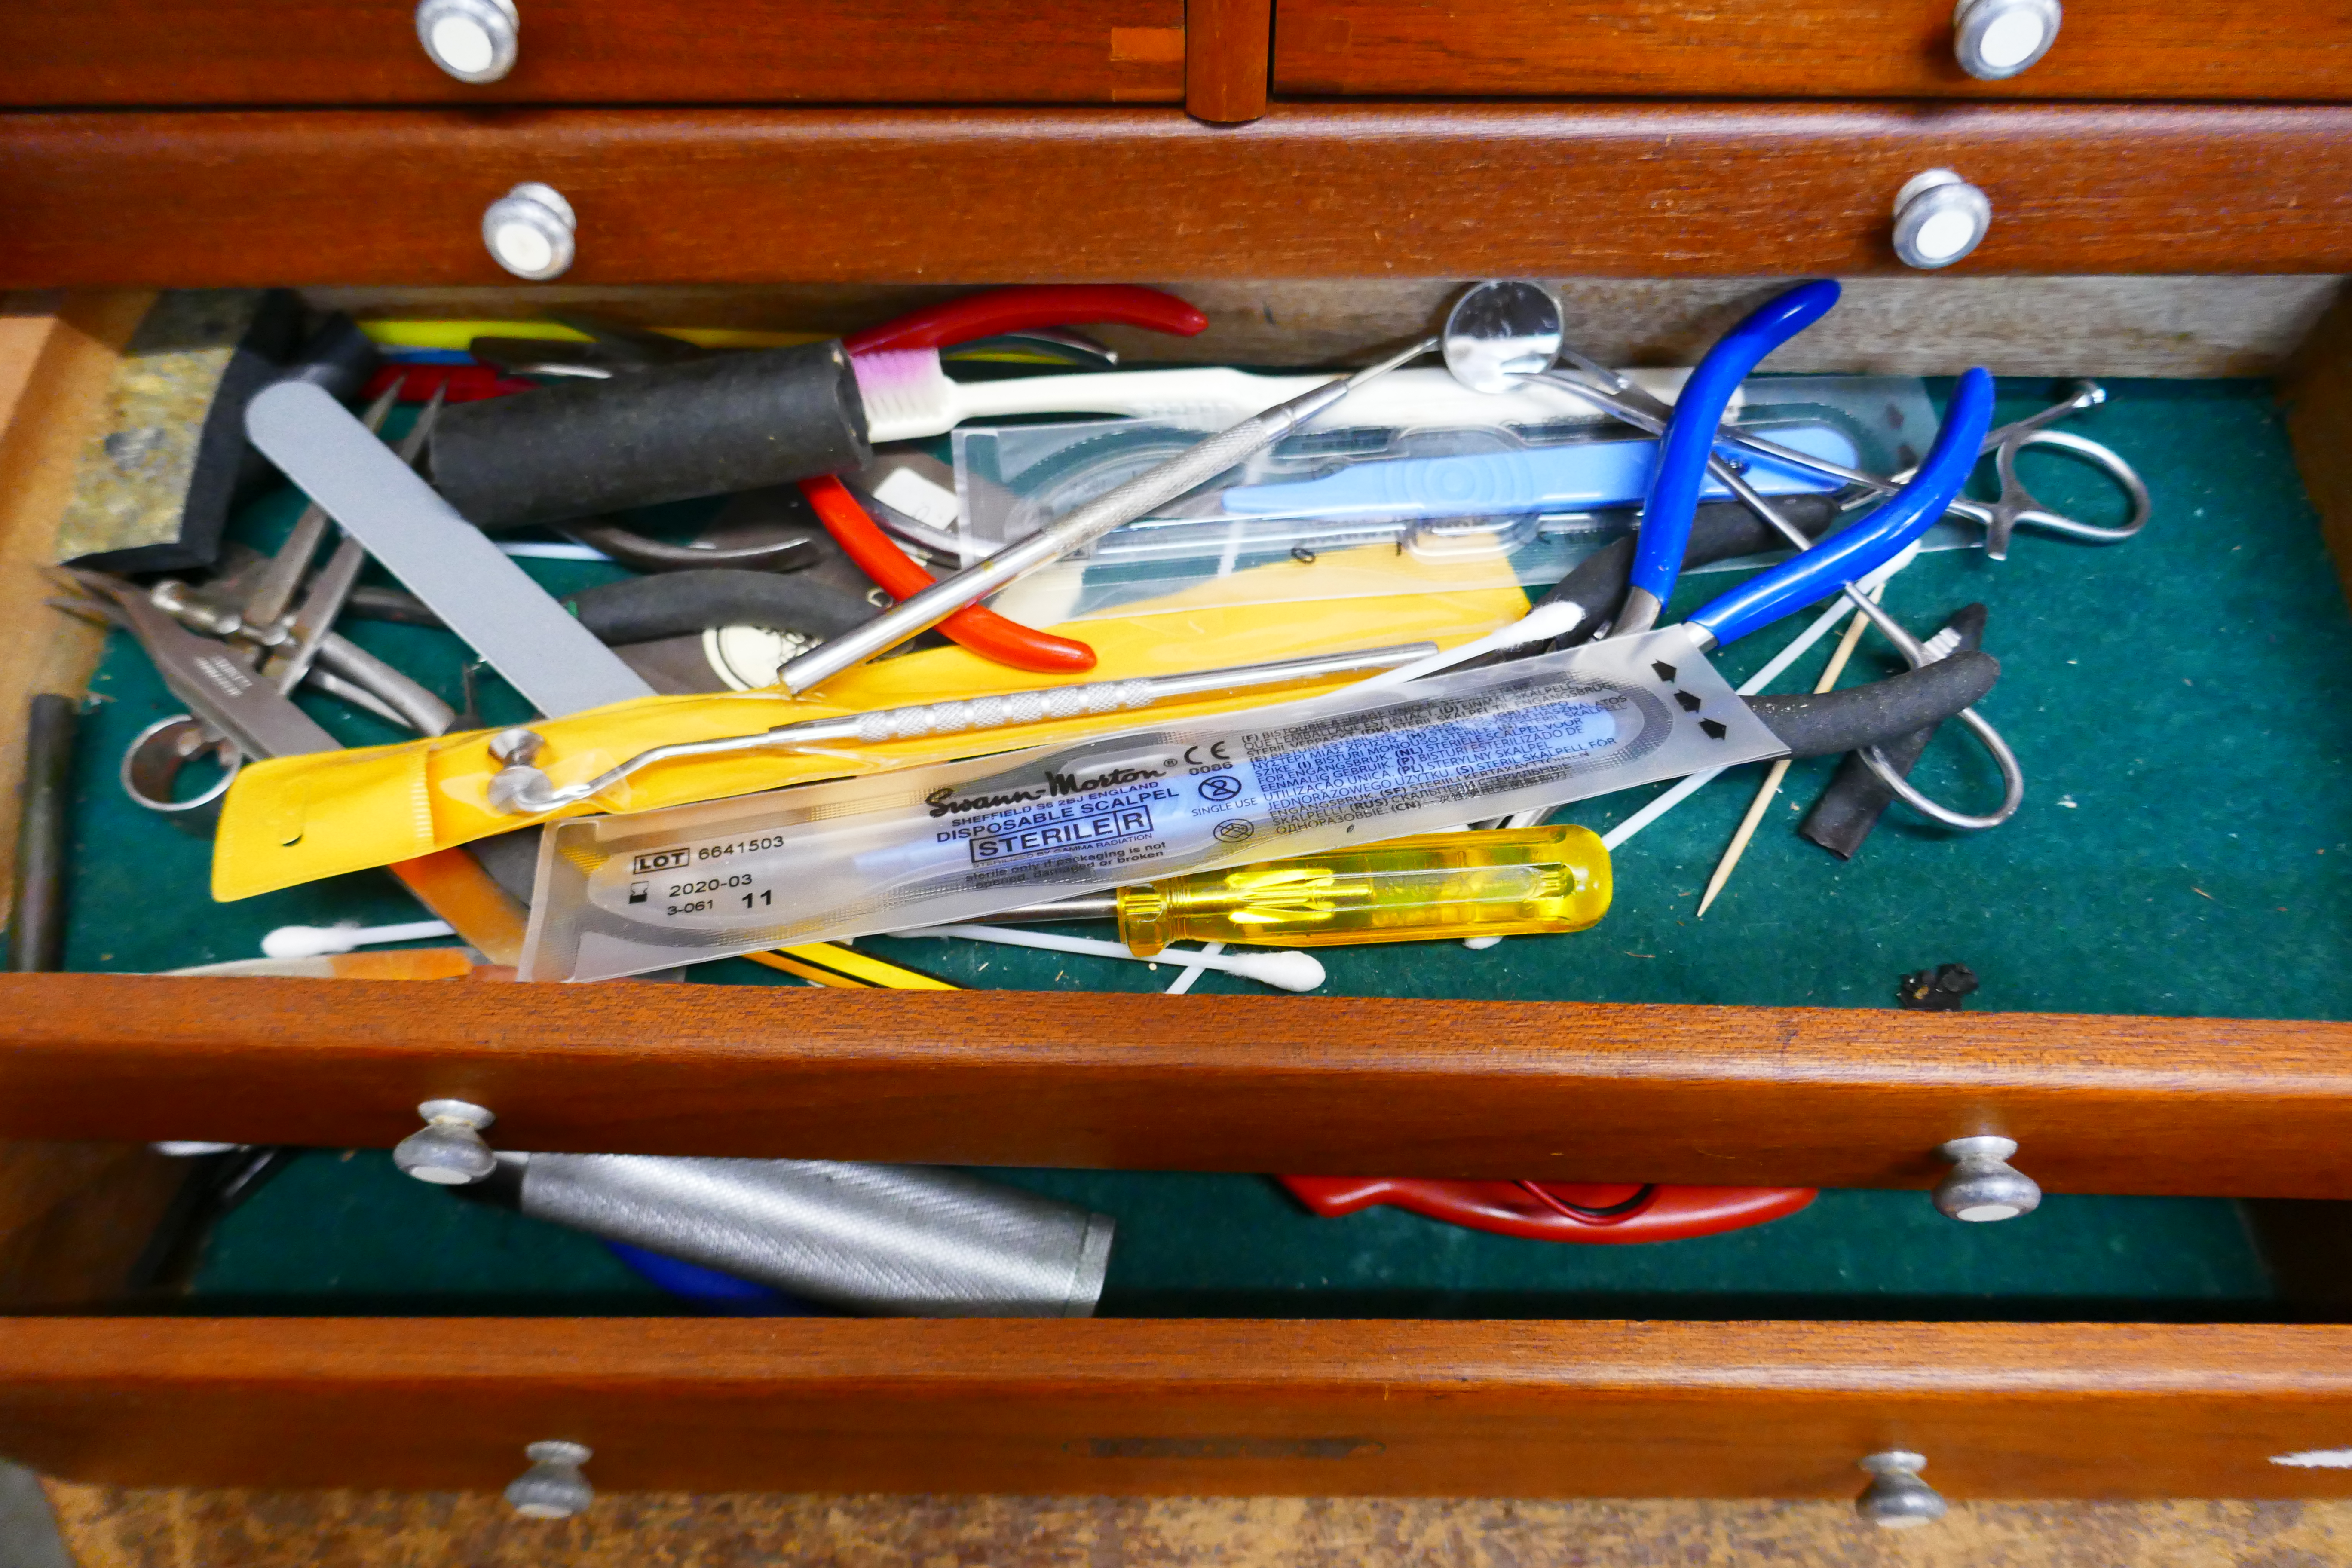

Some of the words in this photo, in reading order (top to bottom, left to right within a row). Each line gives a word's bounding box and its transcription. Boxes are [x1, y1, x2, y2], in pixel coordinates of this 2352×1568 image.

[1241, 733, 1259, 743] (F)
[1243, 738, 1272, 751] QUE
[1364, 719, 1384, 729] EST
[1439, 704, 1458, 715] (D)
[1246, 744, 1285, 757] STERIL
[1361, 725, 1390, 736] (DK)
[1393, 717, 1436, 730] STERIL
[1437, 706, 1490, 723] SKALPEL
[1250, 754, 1267, 763] (E)
[1270, 744, 1319, 759] BISTURI
[1323, 735, 1372, 749] ESTERIL
[1418, 721, 1453, 732] SOLO
[1492, 709, 1520, 719] (GR)
[1406, 731, 1426, 741] (H)
[1429, 723, 1472, 737] STERIL
[1189, 761, 1233, 775] 0086
[1255, 763, 1295, 777] SZIKE.
[1297, 760, 1312, 770] (I)
[1314, 750, 1364, 766] BISTURI
[1368, 735, 1438, 756] MONOUSO
[1258, 773, 1285, 784] FOR
[1288, 752, 1393, 778] ENGANGSBRUK.
[1394, 746, 1423, 759] (NL)
[1426, 735, 1483, 752] STERIELE
[1486, 724, 1544, 741] SCALPEL
[1544, 717, 1583, 730] VOOR
[1261, 772, 1329, 792] EENMALIG
[1332, 760, 1394, 779] GEBRUIK.
[1396, 756, 1415, 767] (P)
[1419, 746, 1469, 762] BISTURI
[1471, 728, 1564, 753] ESTERILIZADO
[1566, 725, 1585, 736] DE
[1397, 763, 1424, 777] (PL)
[1427, 751, 1491, 770] STERYLNY
[1494, 740, 1553, 758] SKALPEL
[1267, 779, 1391, 811] JEDNORAZOWEGO
[1455, 764, 1474, 775] (S)
[1476, 755, 1520, 771] STERIL
[1522, 743, 1587, 762] SKALPELL
[1379, 785, 1407, 798] (SF)
[1409, 775, 1461, 791] STERIILI
[936, 806, 1075, 843] DISPOSABLE
[1080, 786, 1180, 814] SCALPEL
[951, 805, 1032, 827] SHEFFIELD
[1088, 781, 1159, 800] ENGLAND
[1191, 802, 1233, 817] SINGLE
[1235, 797, 1258, 808] USE
[1272, 805, 1346, 826] SKALPELLI.
[1349, 797, 1388, 812] (RUS)
[1391, 799, 1421, 814] (CN)
[979, 818, 1118, 857] STERILE
[1123, 812, 1145, 832] R
[1054, 842, 1093, 855] GAMMA
[1096, 832, 1152, 848] RADIATION
[639, 852, 685, 870] LOT
[698, 836, 784, 860] 6641503
[965, 867, 1008, 882] sterile
[1055, 848, 1125, 867] packaging
[1129, 845, 1140, 854] is
[1144, 841, 1166, 851] not
[1099, 858, 1113, 867] or
[1117, 849, 1164, 864] broken
[667, 900, 713, 916] 3-061
[742, 889, 772, 909] 11
[669, 874, 752, 897] 2020-03
